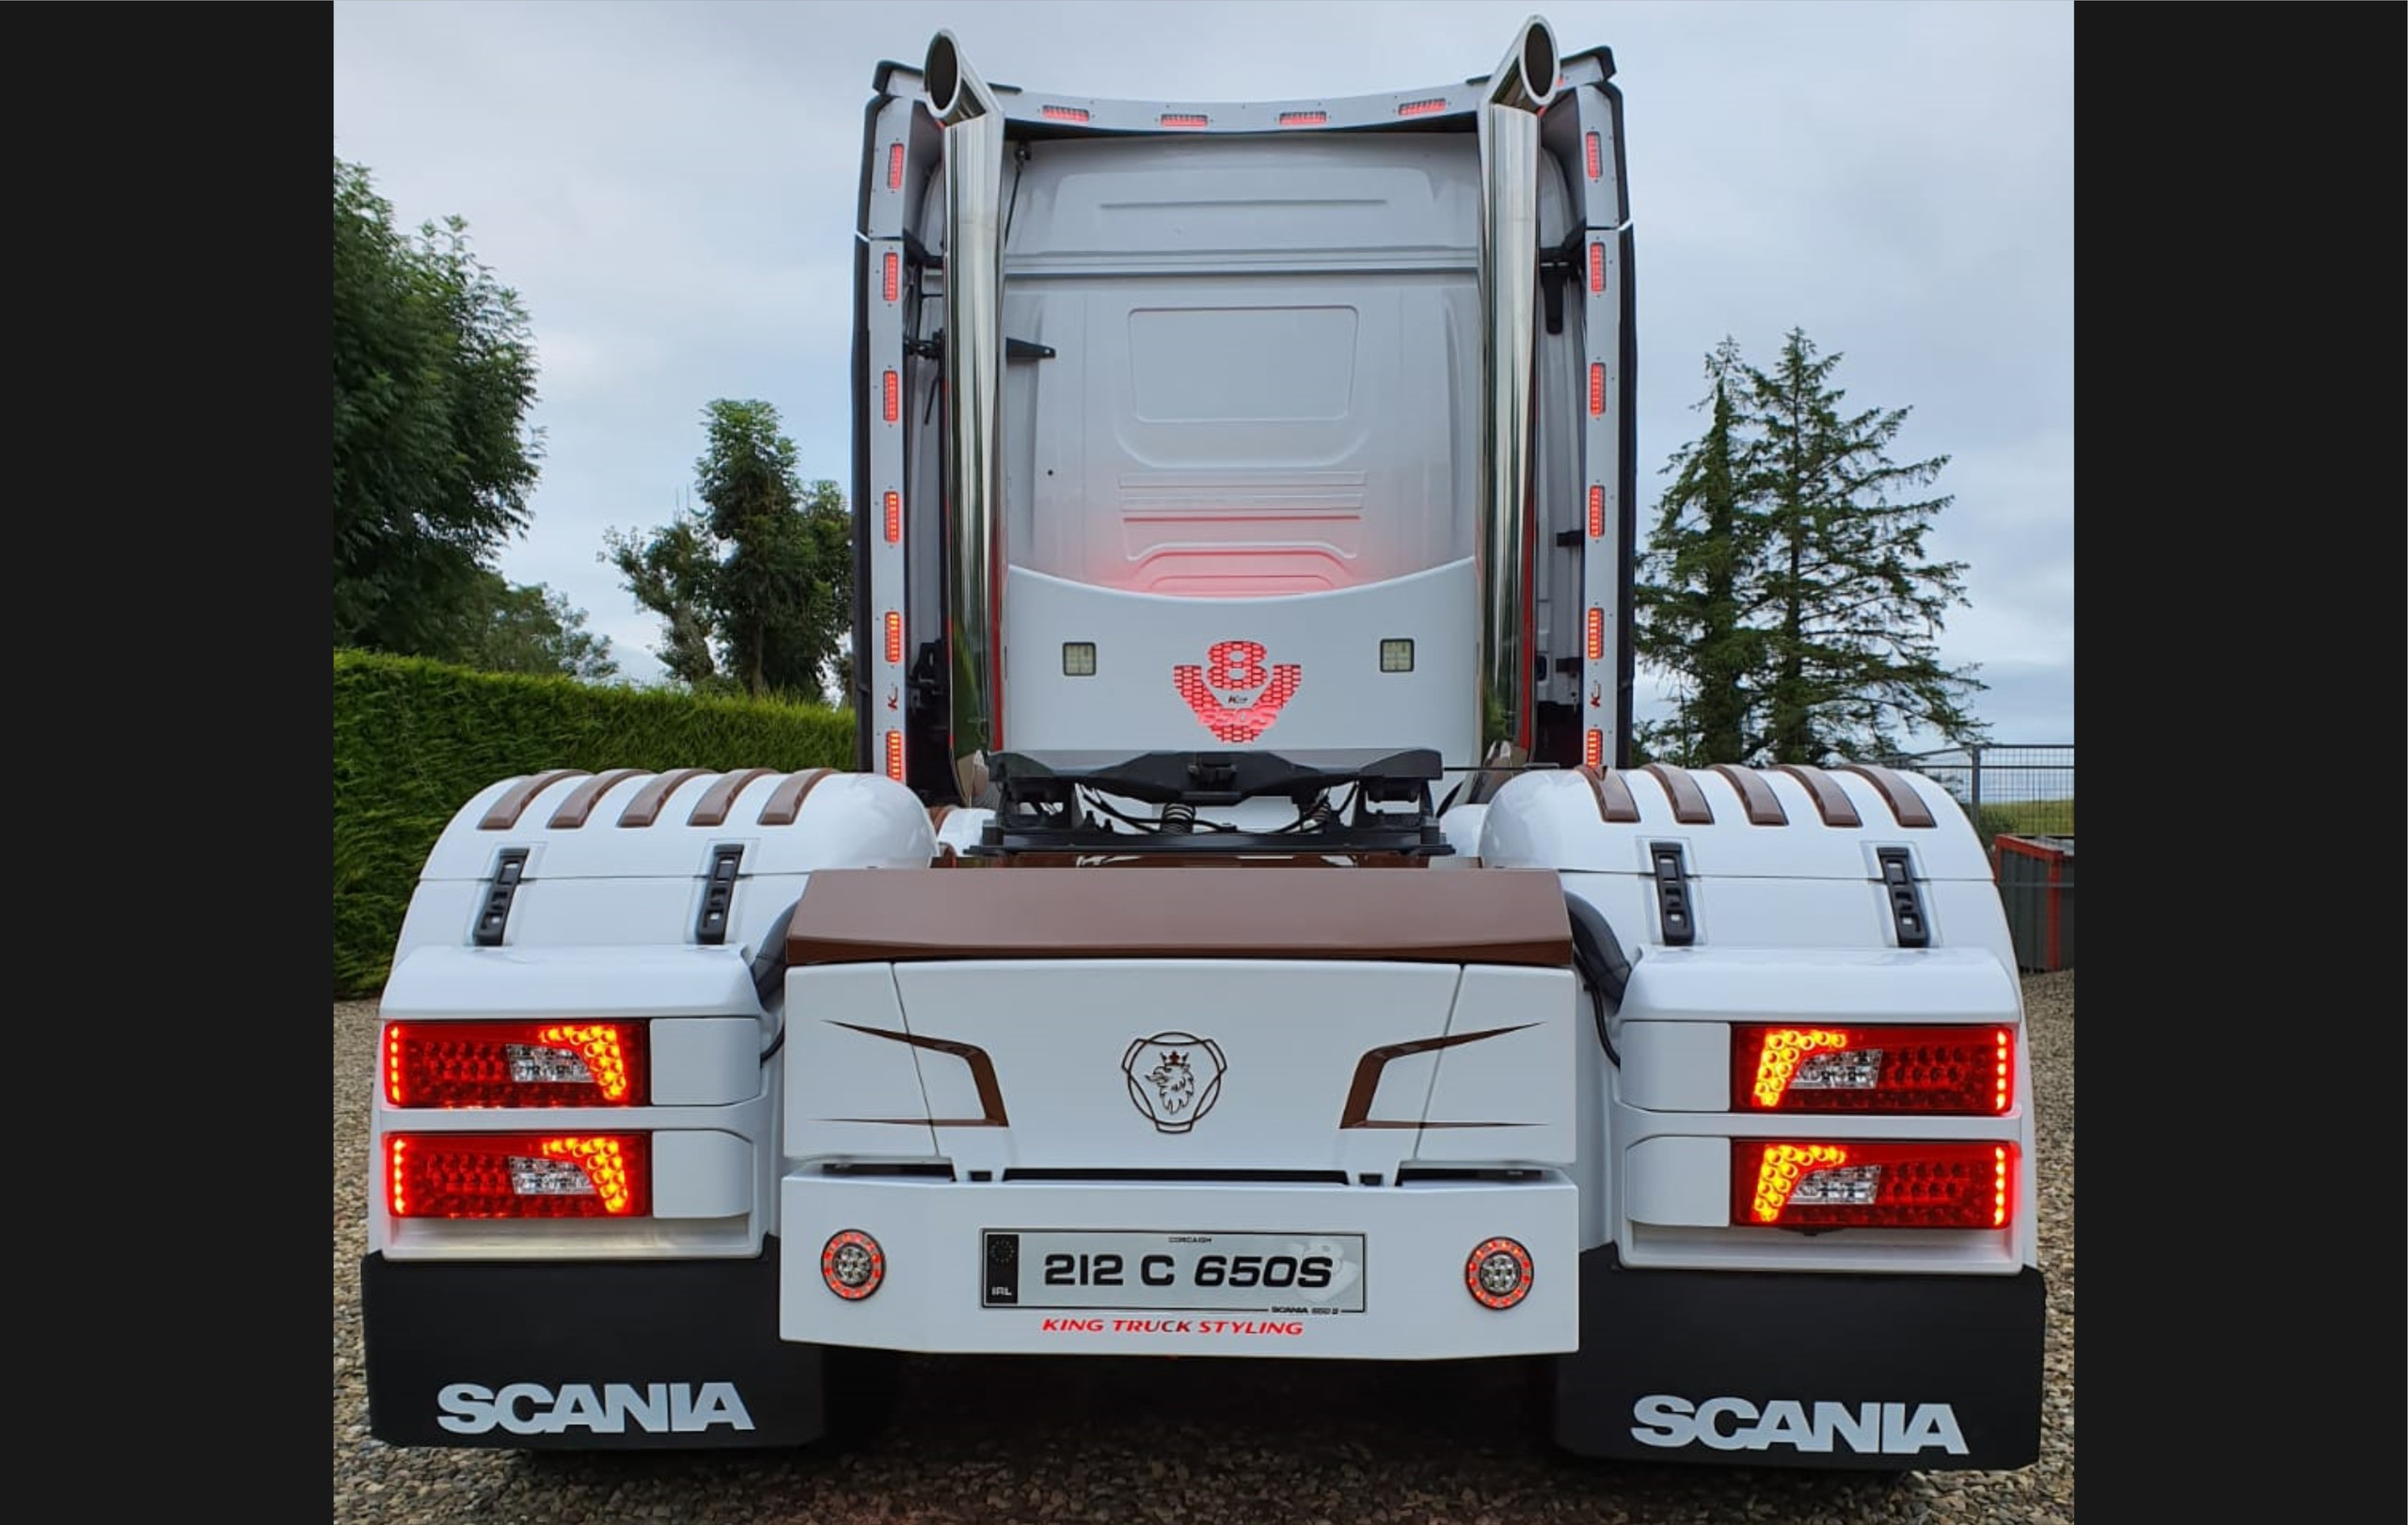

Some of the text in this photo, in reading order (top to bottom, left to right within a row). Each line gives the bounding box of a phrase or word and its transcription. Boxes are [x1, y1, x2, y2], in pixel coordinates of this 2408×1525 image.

[1044, 1254, 1124, 1286] 212
[1141, 1254, 1175, 1286] C
[1195, 1255, 1333, 1288] 650S
[991, 1286, 1012, 1295] IRL
[1042, 1319, 1304, 1336] KING TRUCK STYLING
[436, 1382, 756, 1435] SCANIA
[1630, 1394, 1971, 1455] SCANIA
